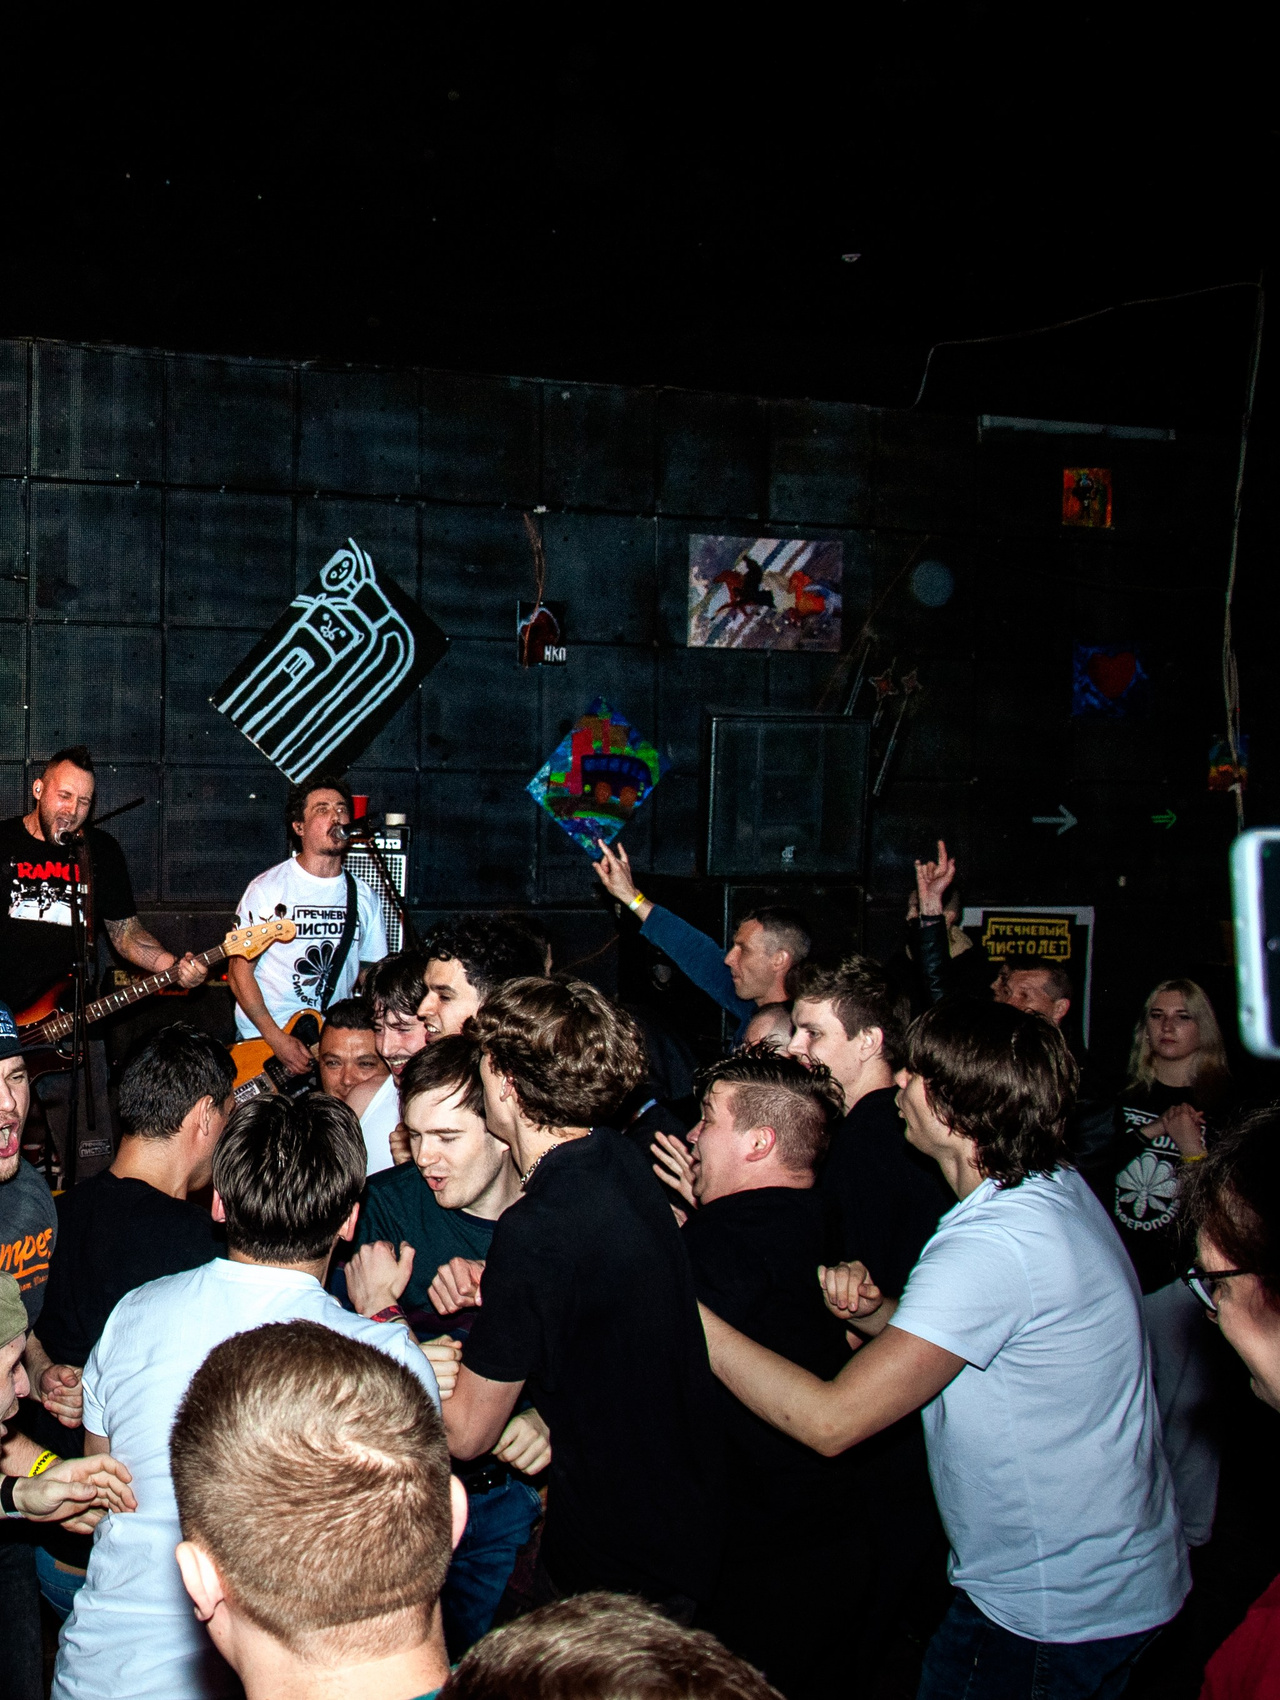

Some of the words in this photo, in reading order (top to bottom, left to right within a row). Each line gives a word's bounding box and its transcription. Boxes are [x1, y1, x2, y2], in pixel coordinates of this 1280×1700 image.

[297, 909, 348, 920] ГРЕЧНЕВ
[295, 922, 347, 936] ПИСТОЛ
[987, 940, 1068, 955] ПИСТОЛЕТ
